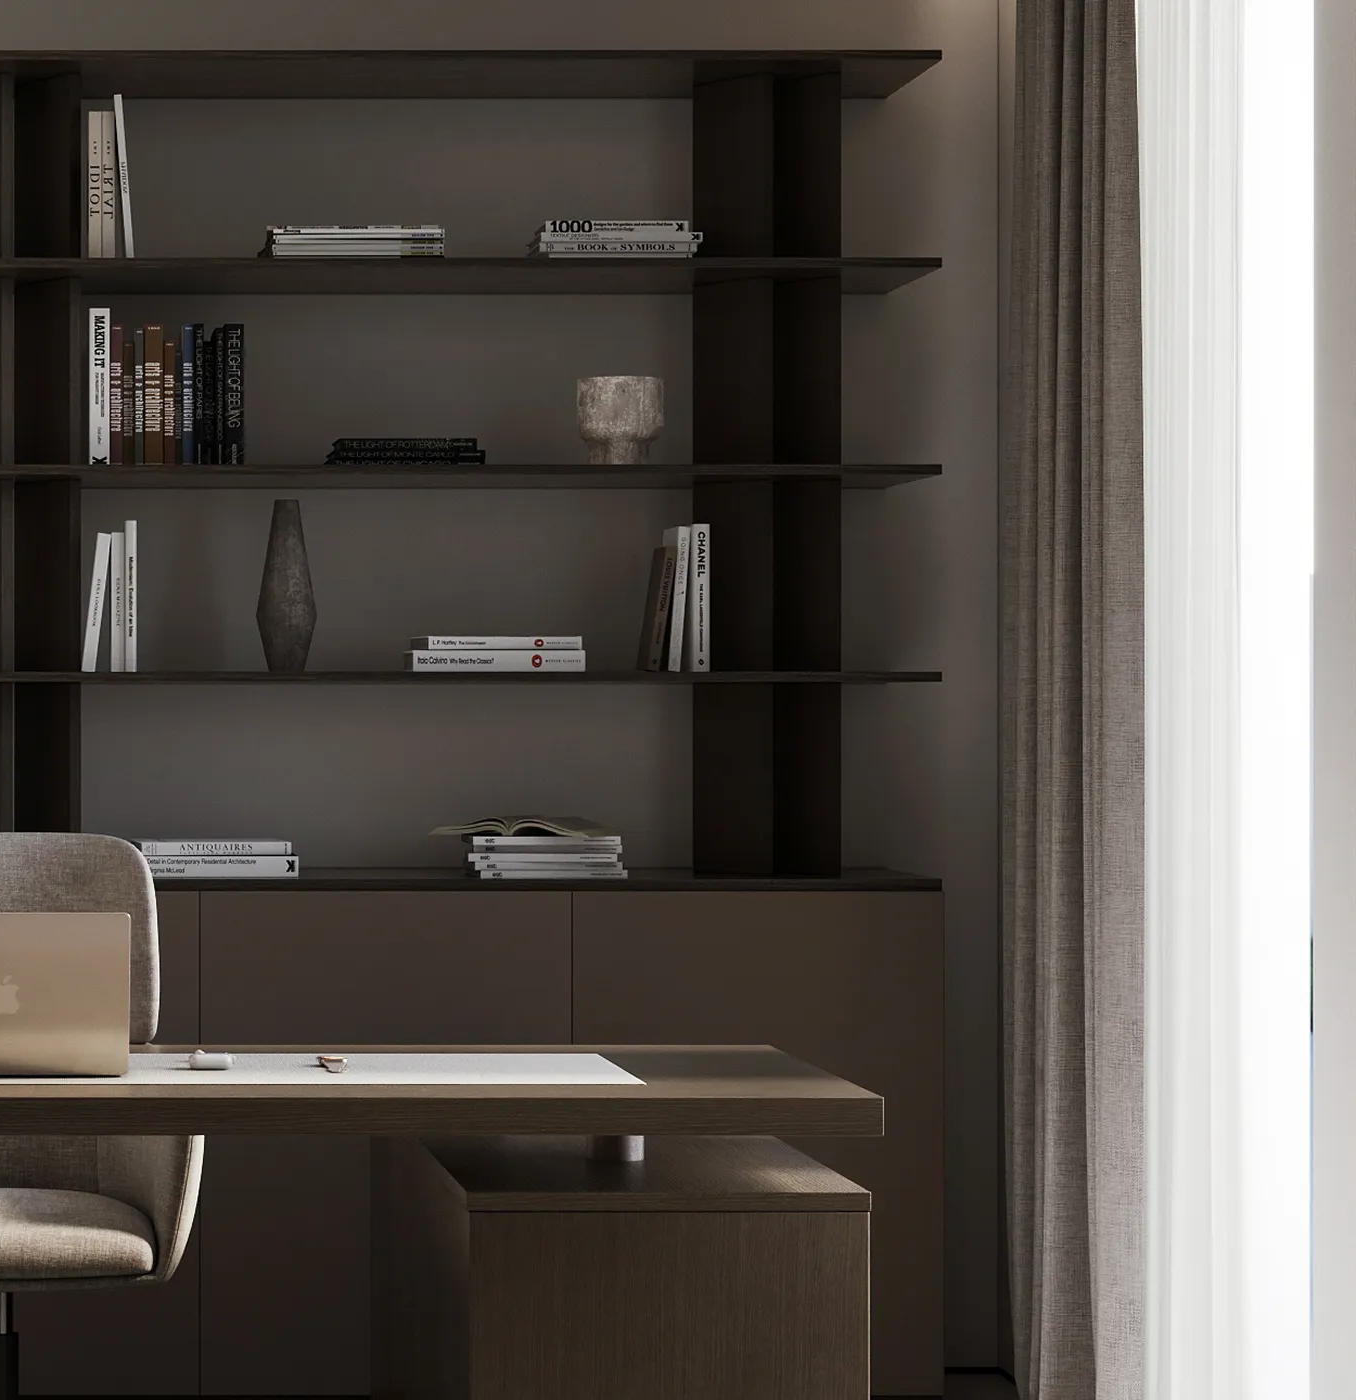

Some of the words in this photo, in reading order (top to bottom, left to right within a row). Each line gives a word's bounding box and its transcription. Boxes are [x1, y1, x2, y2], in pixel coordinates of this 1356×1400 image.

[550, 220, 593, 233] 1000
[94, 315, 105, 355] MAKING
[228, 329, 240, 348] THE
[94, 358, 105, 368] IT
[111, 362, 123, 376] arts
[145, 362, 163, 376] arts
[183, 362, 194, 376] arts
[228, 349, 240, 376] LIGHT
[135, 366, 143, 379] arts
[164, 374, 175, 387] arts
[196, 377, 203, 391] OF
[228, 377, 240, 391] OF
[111, 388, 123, 431] architecture
[135, 390, 143, 432] architecture
[145, 388, 163, 432] architecture
[183, 388, 194, 431] architecture
[164, 398, 175, 436] architecture
[664, 558, 673, 580] LOUIS
[660, 580, 671, 612] VUITTON
[429, 656, 448, 664] Calvino
[180, 844, 253, 852] ANTIQUAIRES
[167, 858, 200, 866] Contemporary
